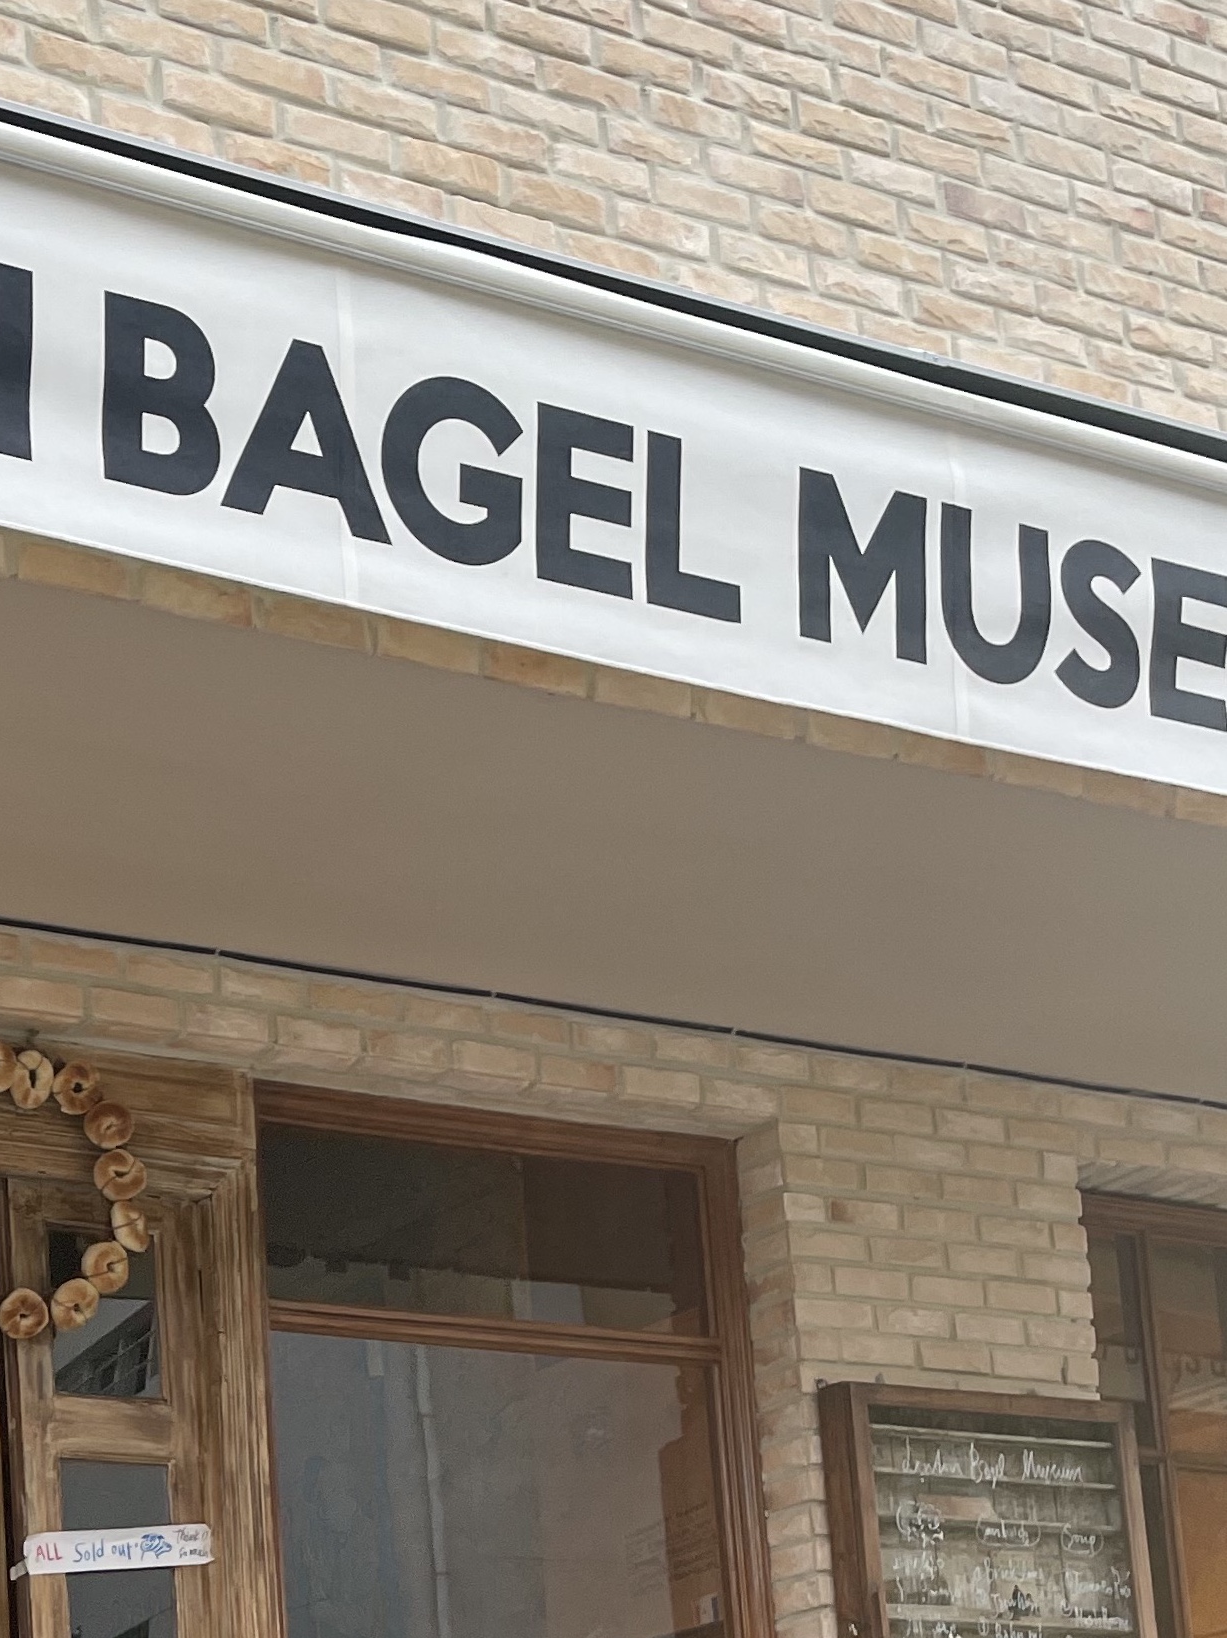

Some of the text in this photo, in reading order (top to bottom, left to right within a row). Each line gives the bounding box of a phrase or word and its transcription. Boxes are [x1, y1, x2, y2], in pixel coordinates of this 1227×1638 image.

[102, 291, 741, 623] BAGEL
[36, 1543, 63, 1561] ALL
[73, 1539, 105, 1563] Sold
